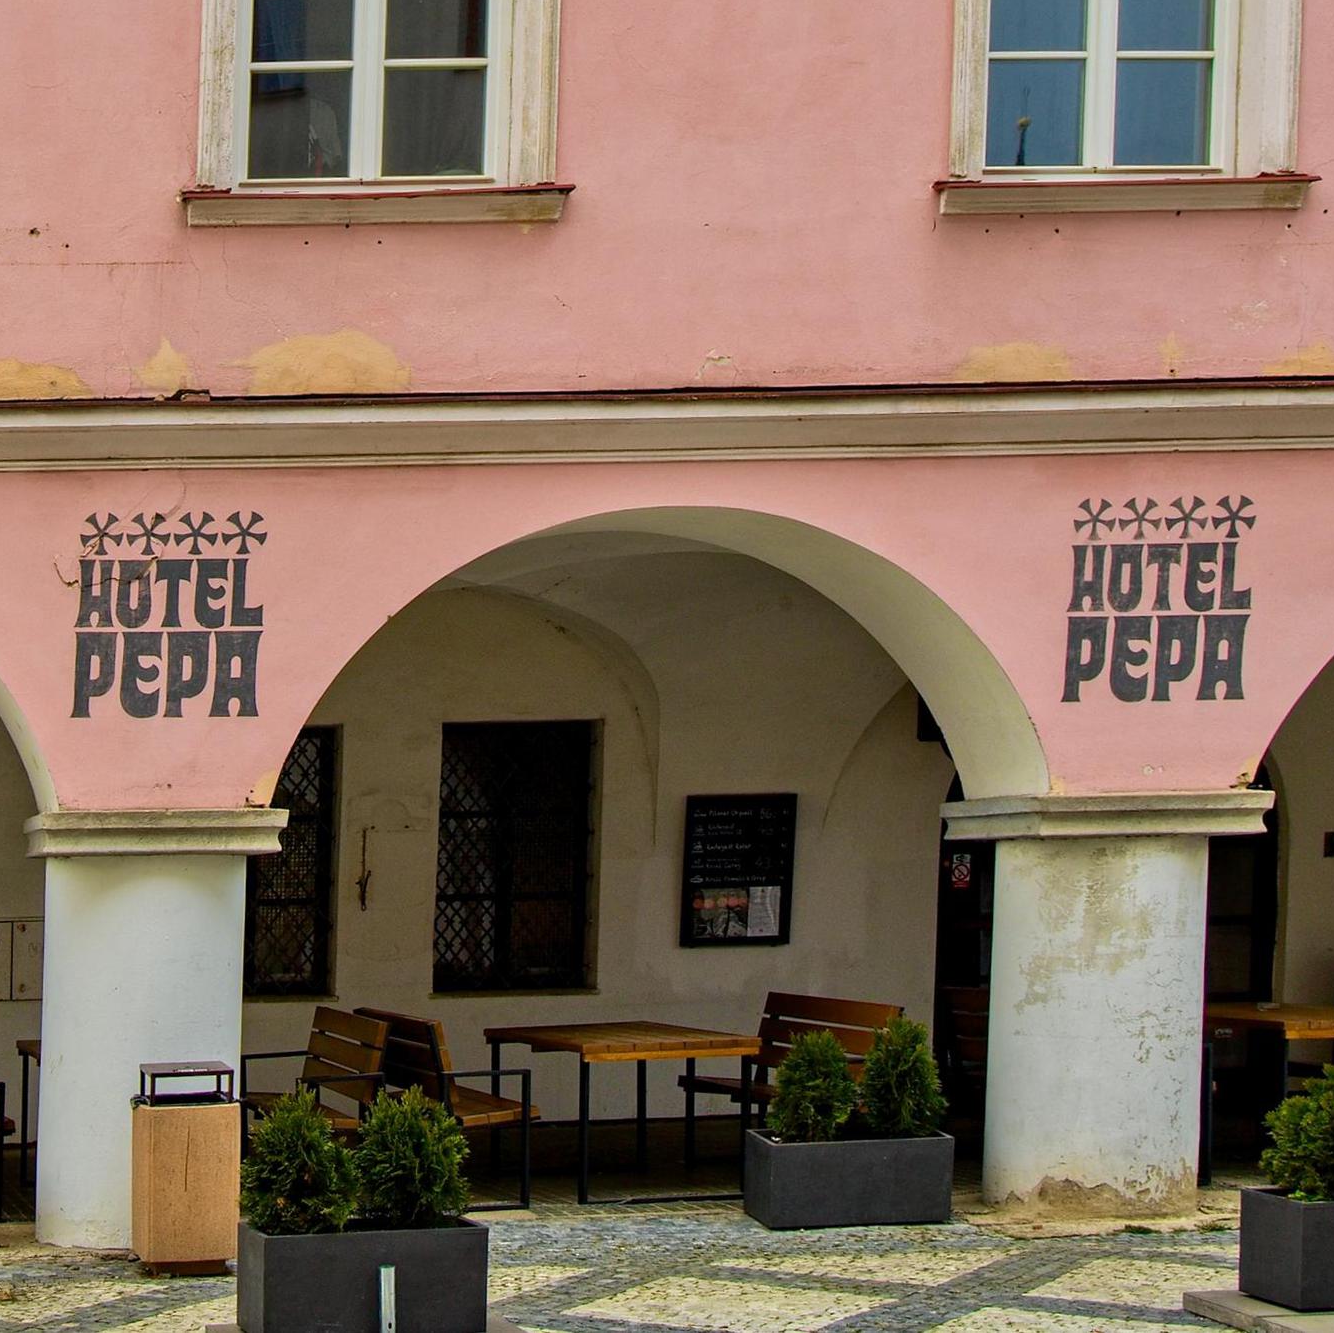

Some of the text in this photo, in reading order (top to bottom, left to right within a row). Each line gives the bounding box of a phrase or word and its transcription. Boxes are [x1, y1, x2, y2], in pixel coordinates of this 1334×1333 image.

[74, 558, 263, 629] HOTEL
[1067, 542, 1252, 612] HOTEL
[70, 631, 263, 718] PEPA
[1061, 614, 1251, 703] PEPA
